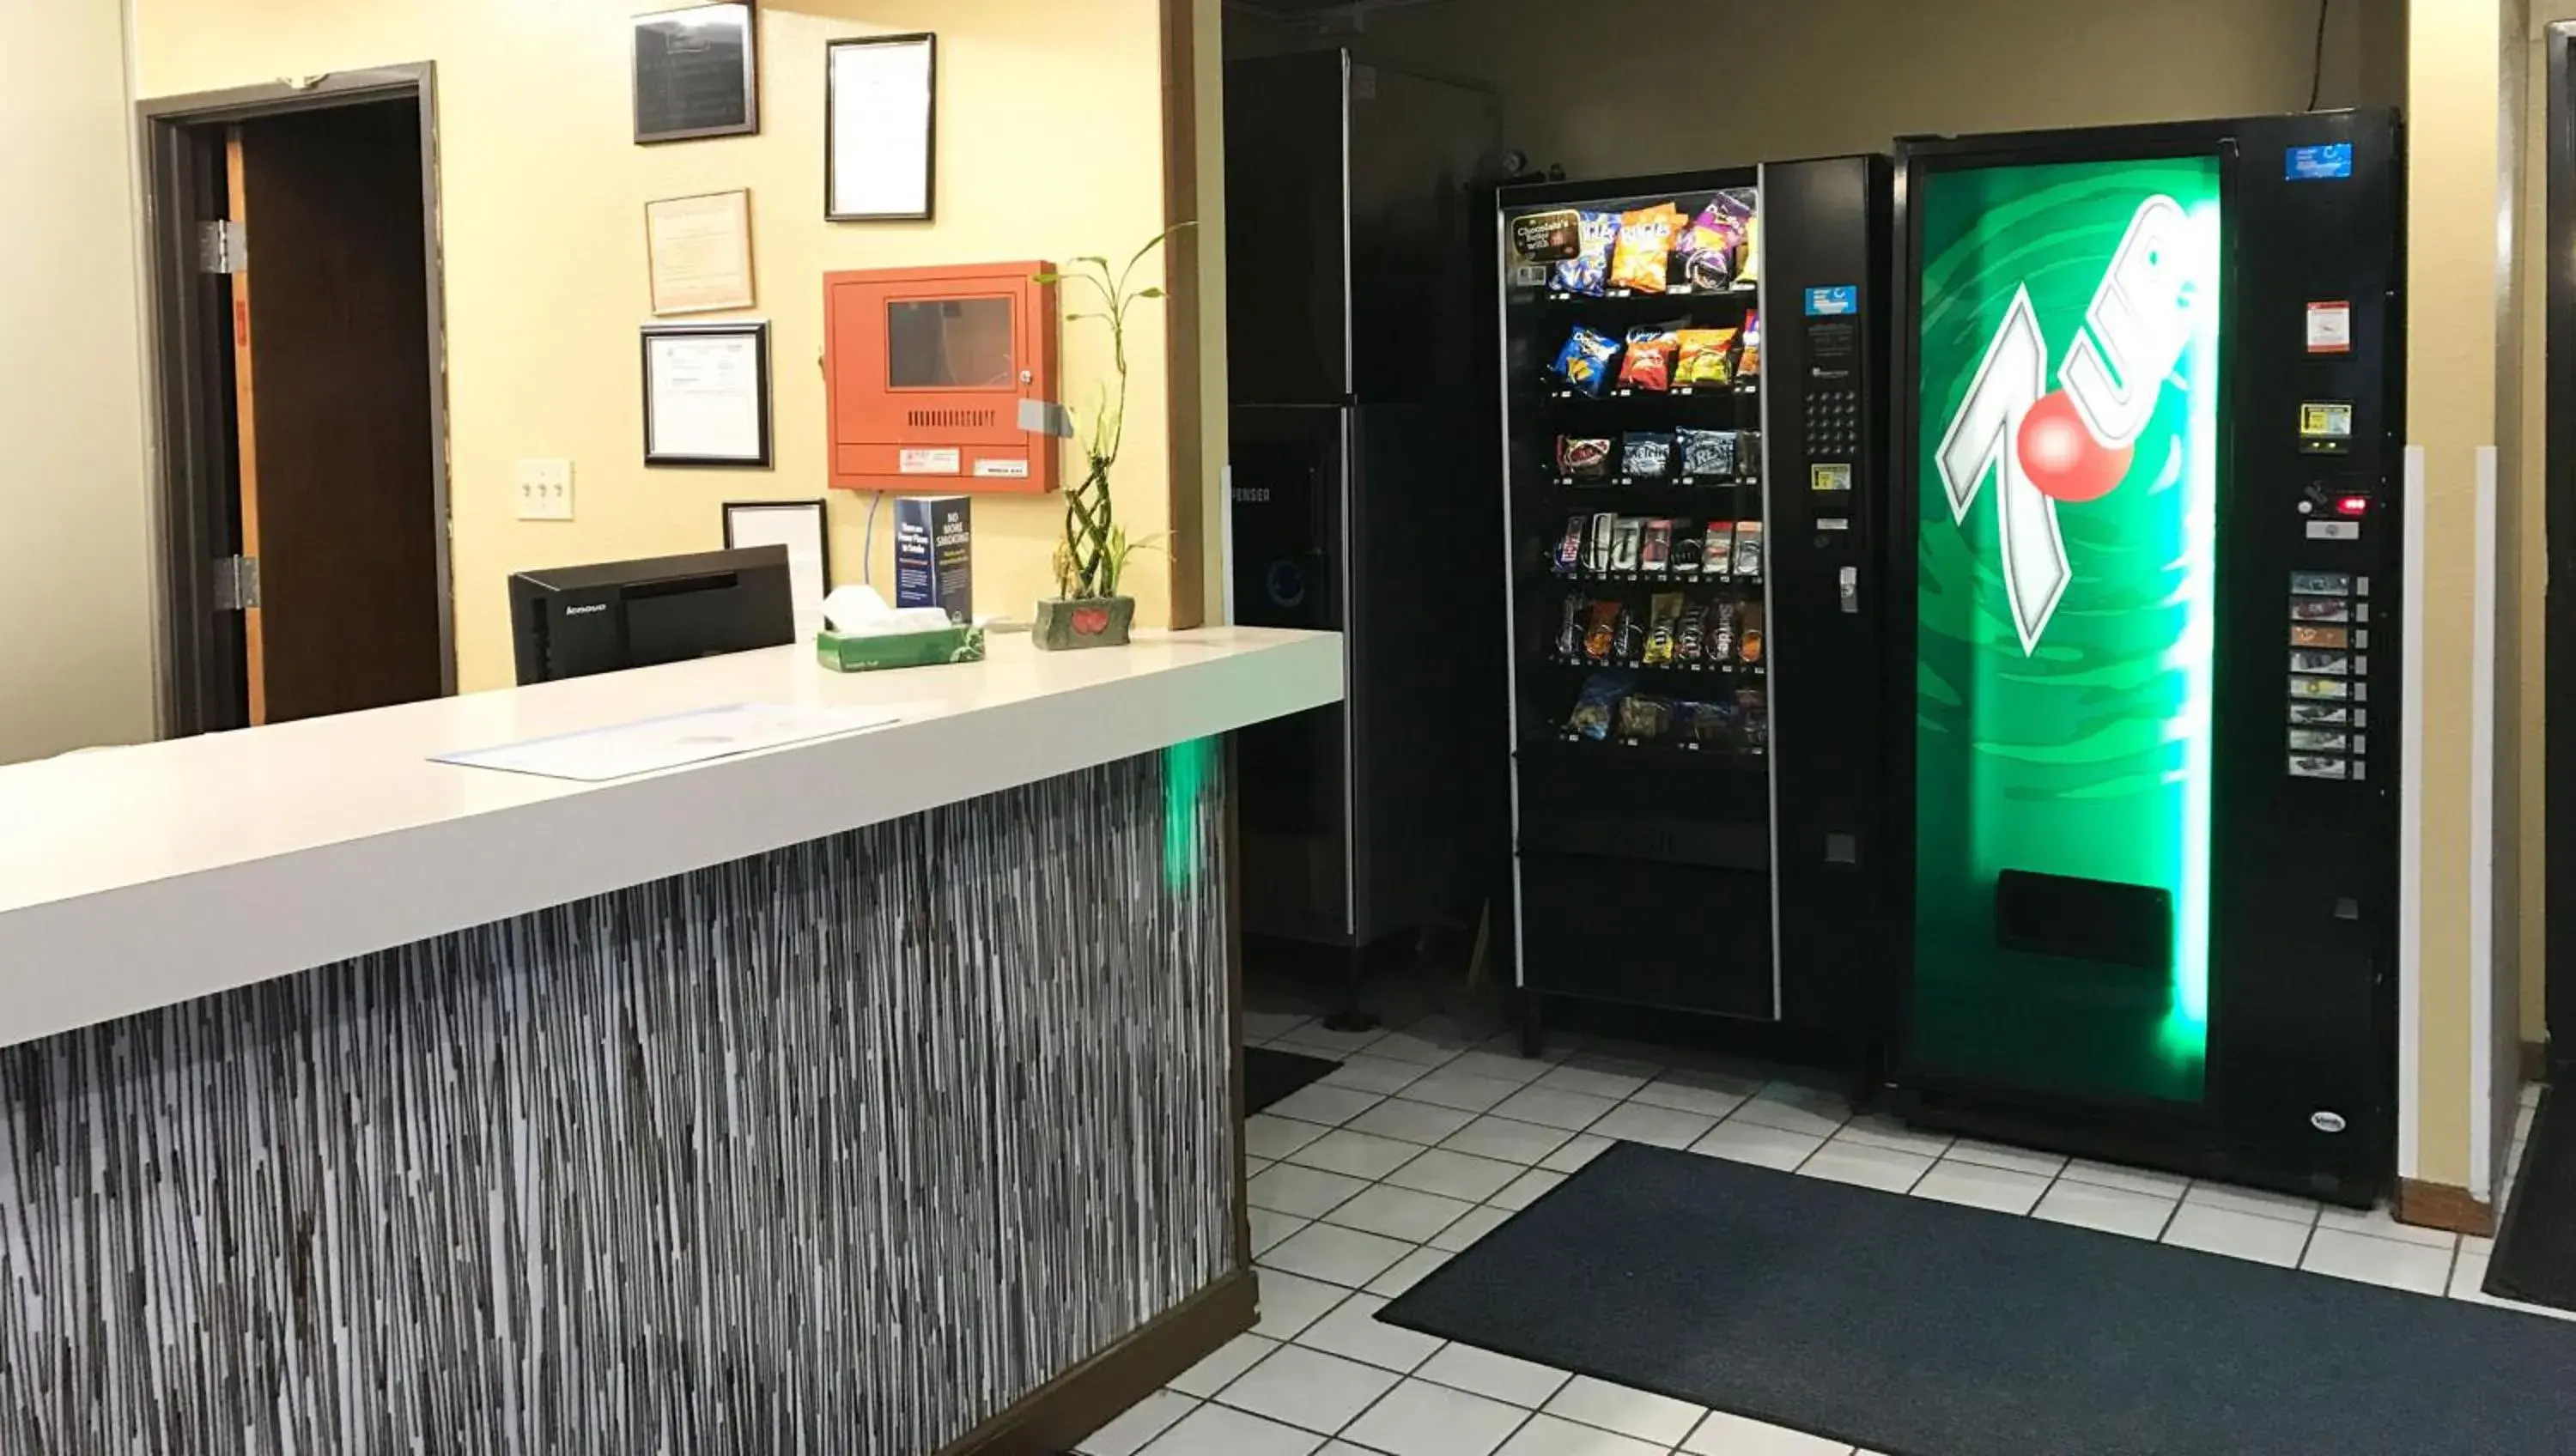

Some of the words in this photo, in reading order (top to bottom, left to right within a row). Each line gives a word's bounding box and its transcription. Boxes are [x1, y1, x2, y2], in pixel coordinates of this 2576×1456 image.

[947, 512, 959, 523] NO
[944, 522, 963, 534] MORE
[936, 533, 969, 546] SMOKING
